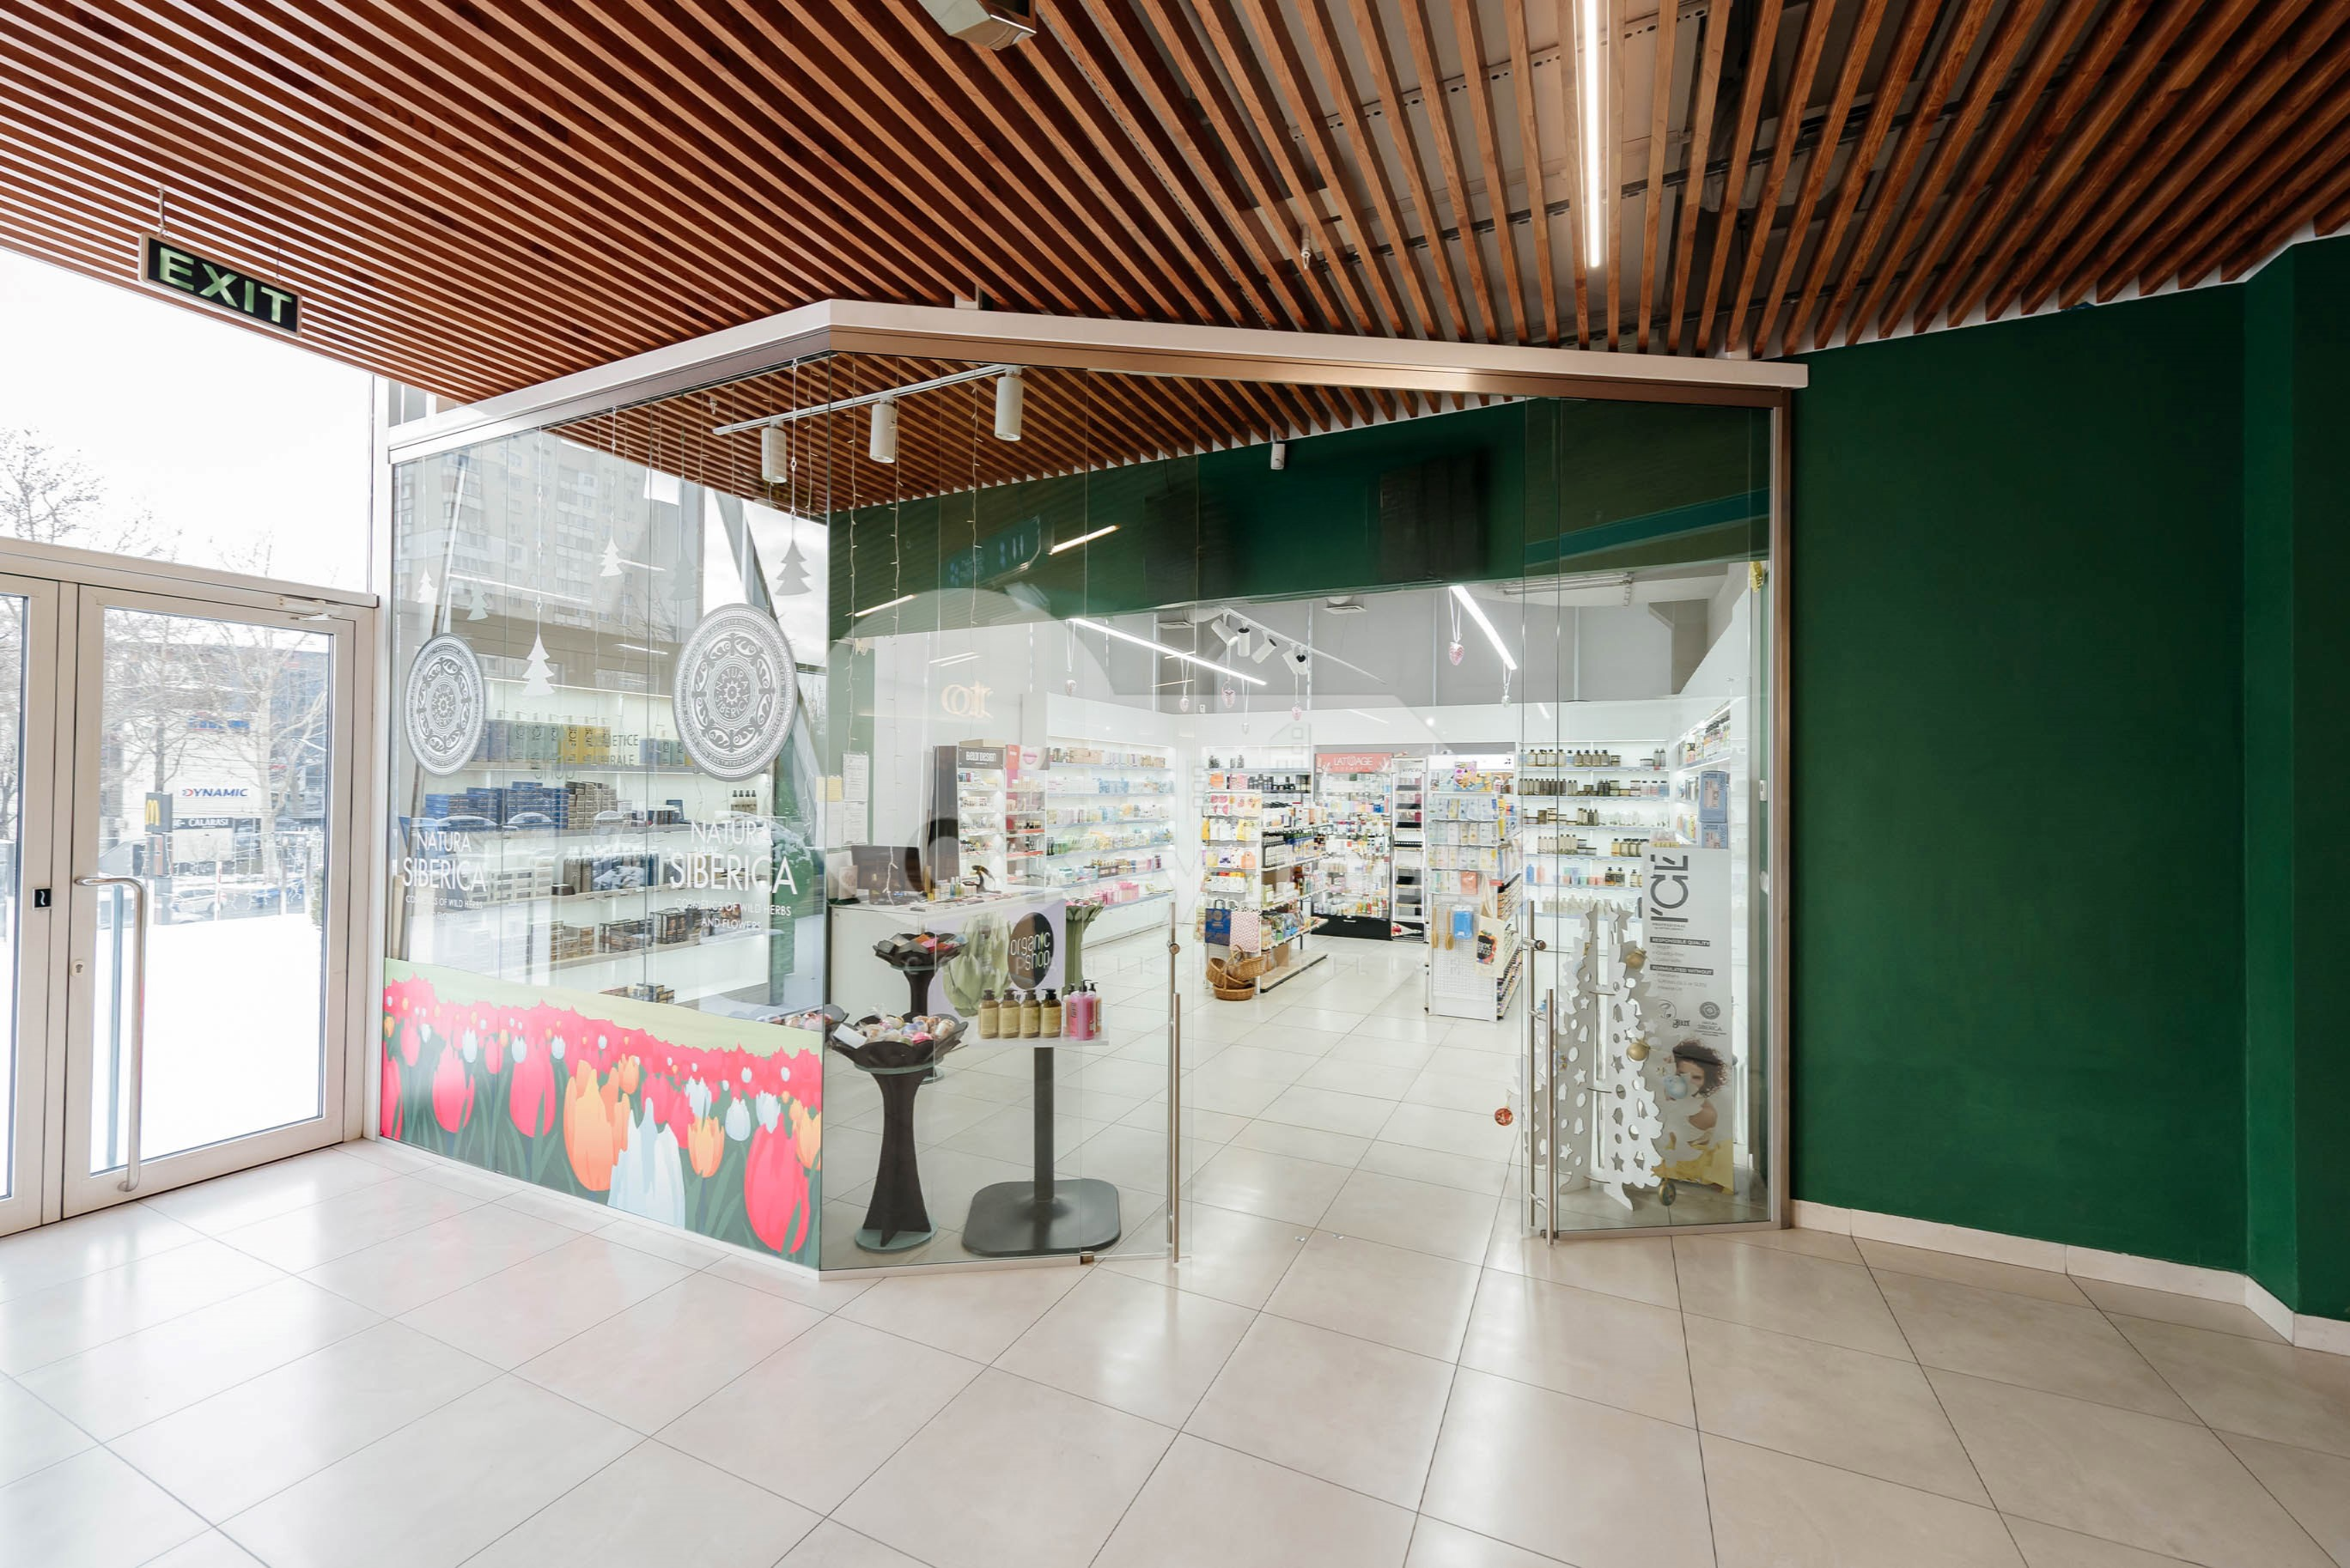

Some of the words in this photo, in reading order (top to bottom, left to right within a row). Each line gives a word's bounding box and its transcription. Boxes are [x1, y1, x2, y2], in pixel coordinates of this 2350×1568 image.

[160, 246, 292, 323] EXIT
[715, 667, 750, 690] NATURA
[715, 692, 750, 718] SIBERICA
[181, 787, 248, 798] DYNAMIC
[417, 830, 472, 853] NATURA
[690, 819, 774, 846] NATURA
[402, 857, 487, 892] SIBERICA
[669, 852, 798, 895] SIBERICA
[440, 897, 447, 906] OF
[448, 899, 463, 908] WILD
[464, 900, 483, 909] HERBS
[724, 902, 739, 912] OF
[740, 903, 761, 914] WILD
[764, 904, 792, 916] HERBS
[701, 917, 721, 928] AND
[1010, 931, 1050, 956] organic
[1025, 950, 1050, 971] shop
